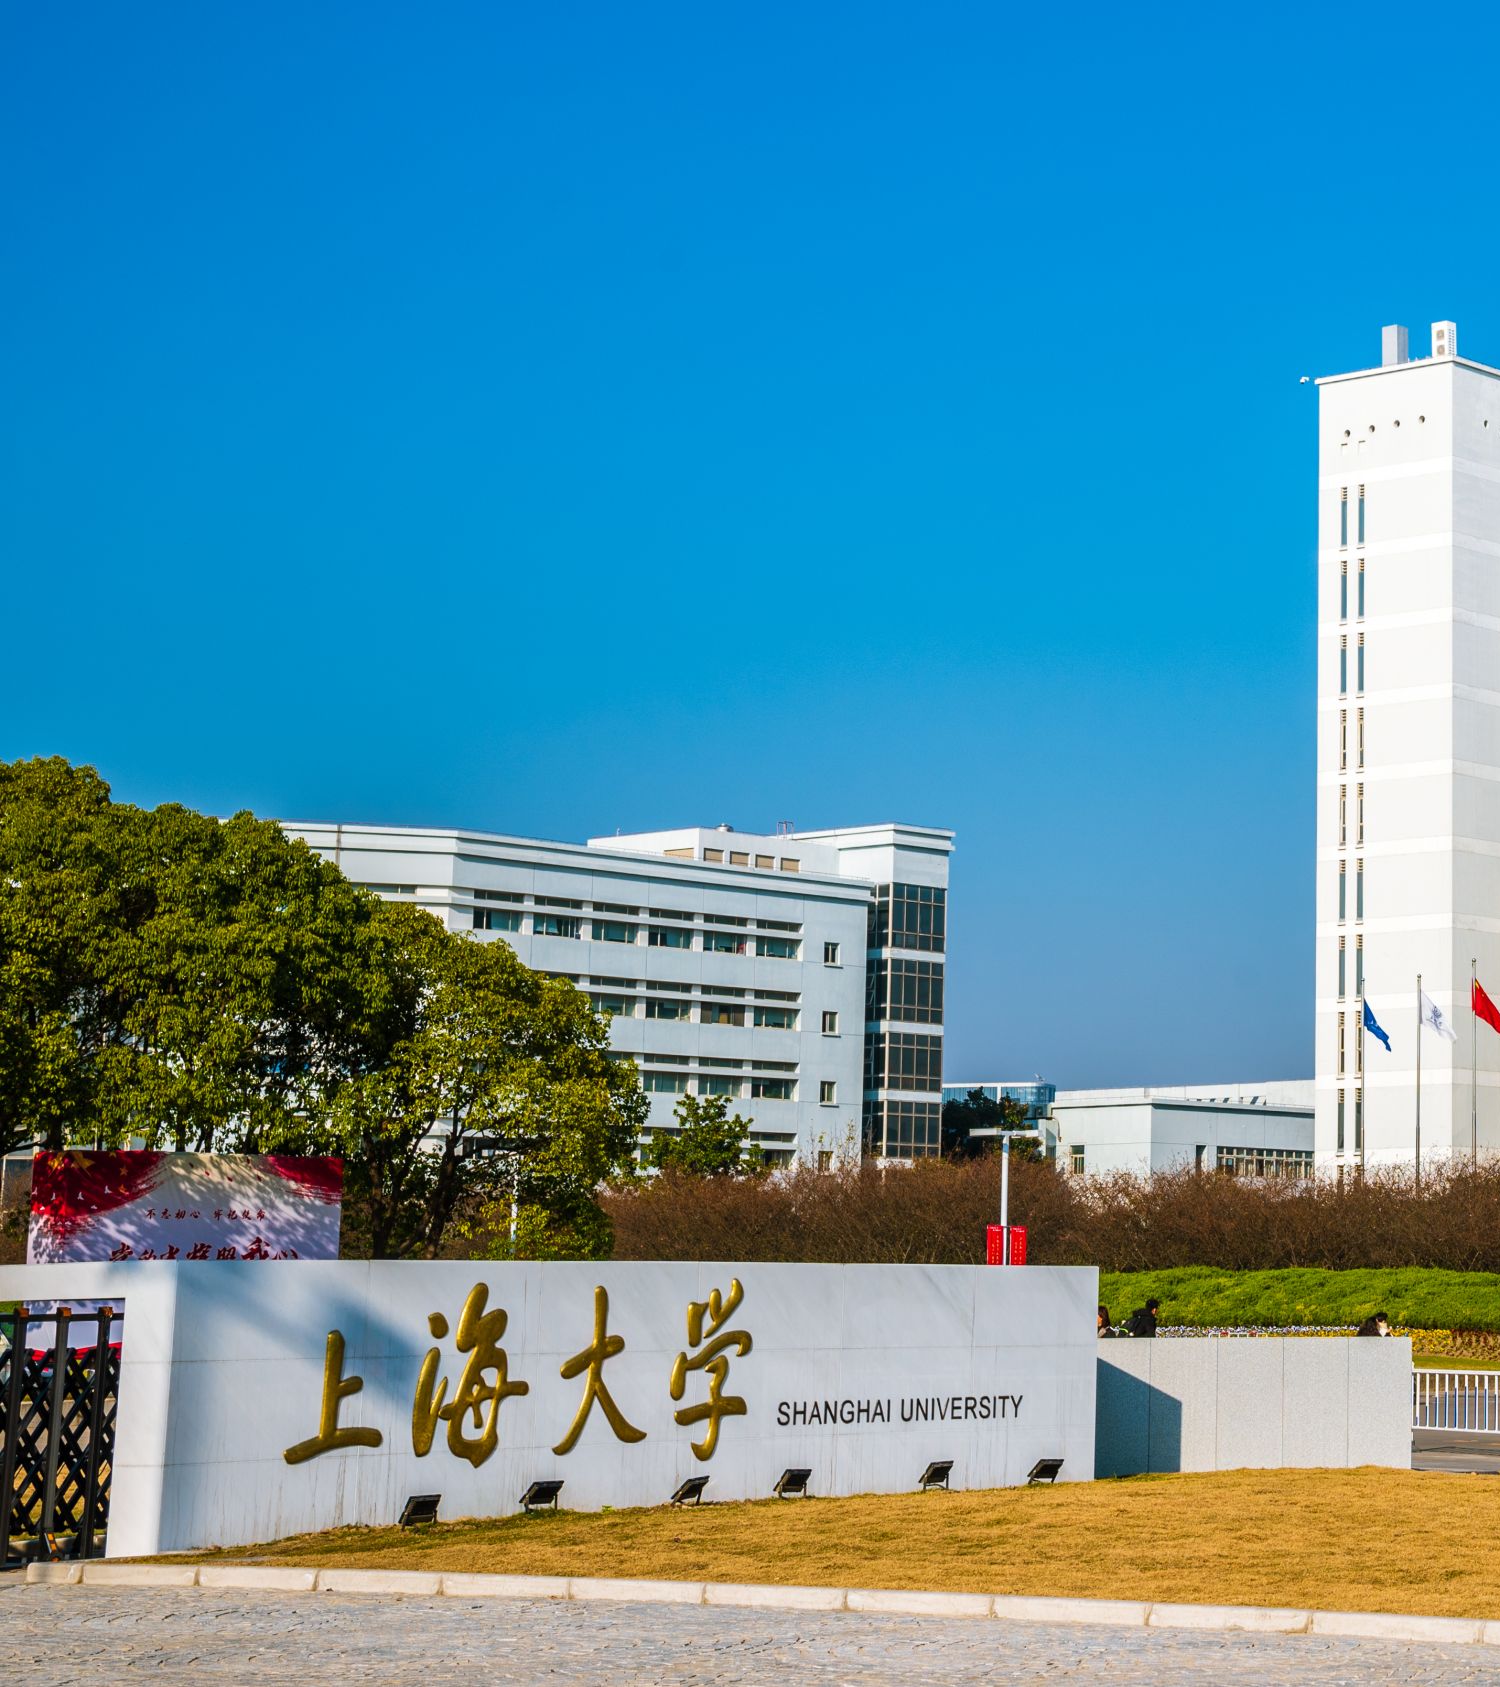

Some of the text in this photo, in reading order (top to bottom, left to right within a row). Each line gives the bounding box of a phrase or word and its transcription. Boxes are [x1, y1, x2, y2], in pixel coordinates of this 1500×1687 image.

[282, 1279, 752, 1467] 上海大学
[776, 1395, 1023, 1426] SHANGHAI UNIVERSITY
